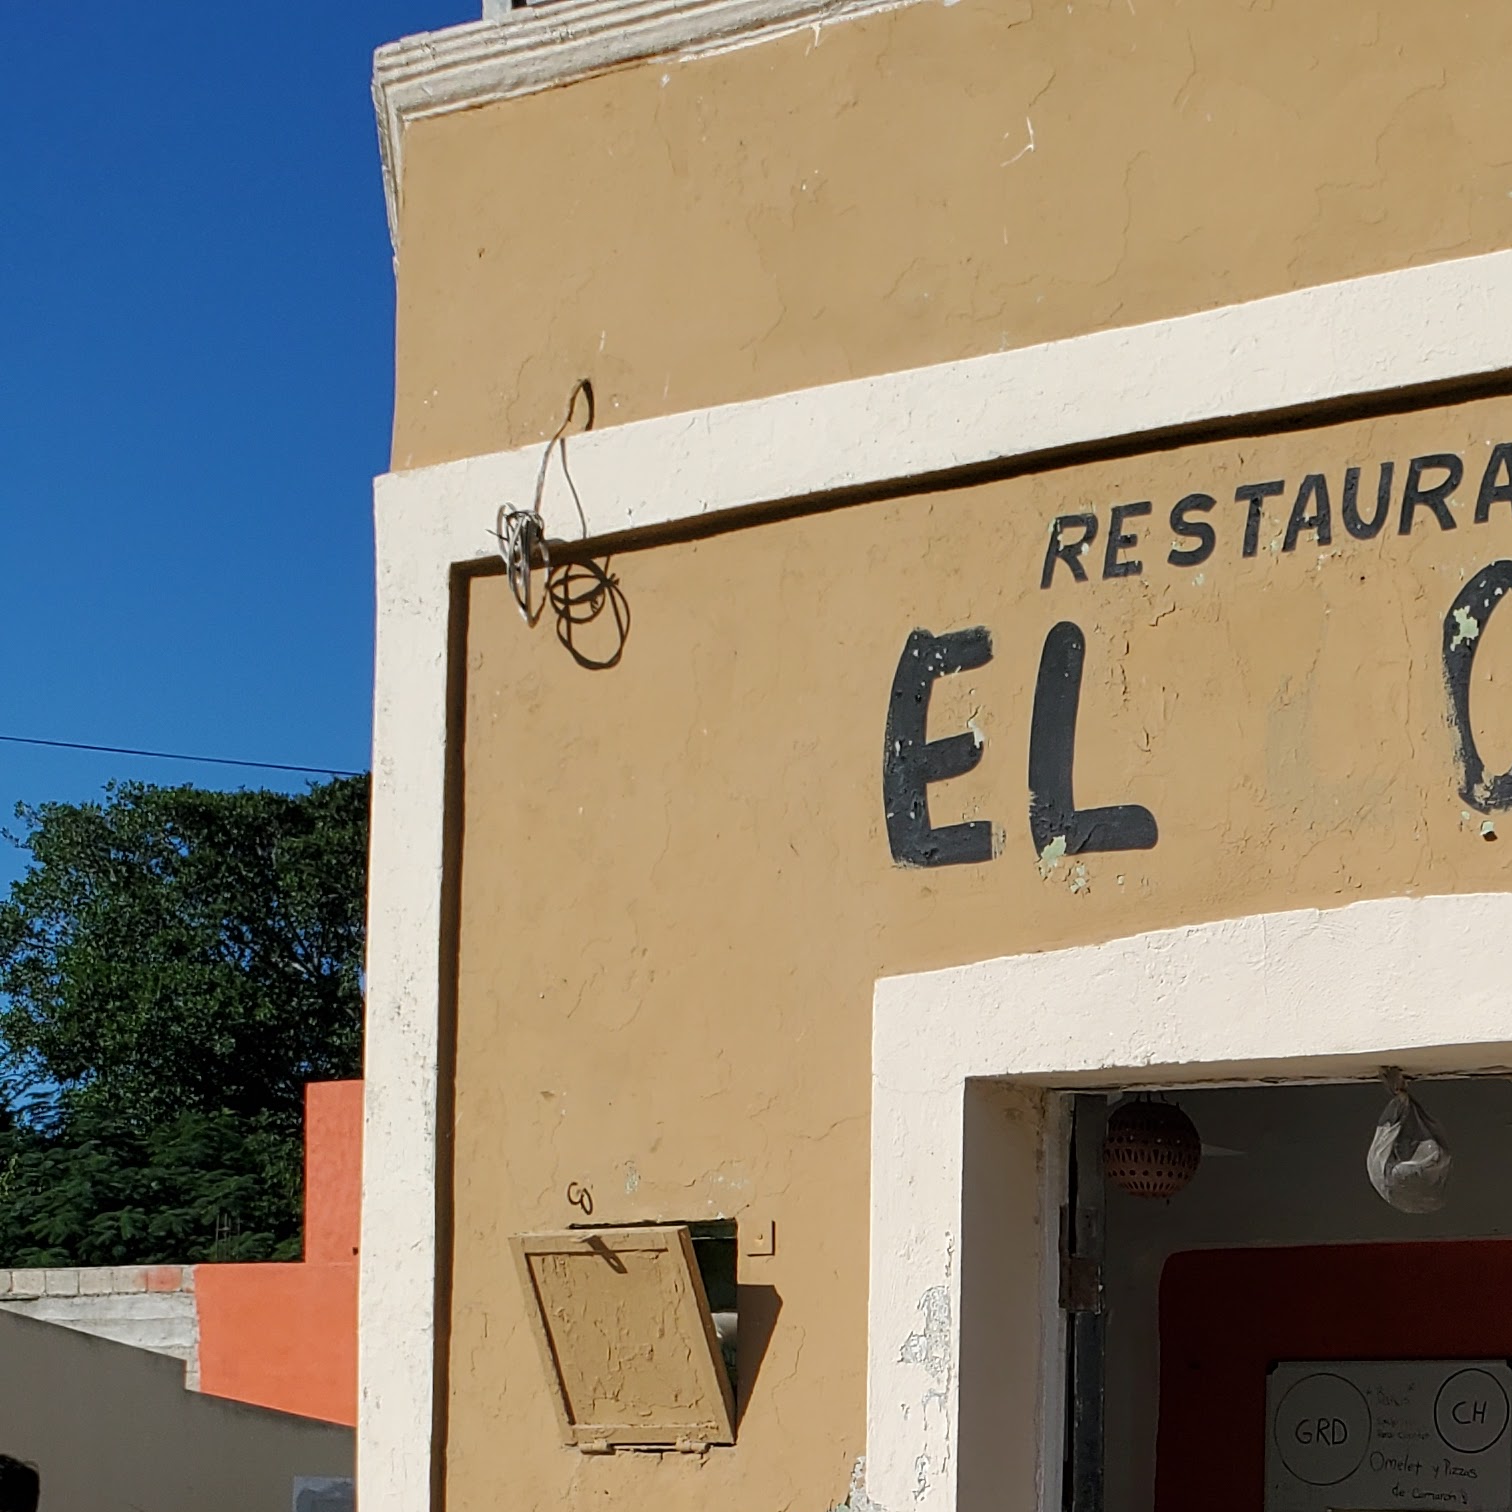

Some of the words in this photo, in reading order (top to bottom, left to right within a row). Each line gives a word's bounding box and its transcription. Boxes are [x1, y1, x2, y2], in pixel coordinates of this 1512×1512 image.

[884, 619, 1158, 868] EL
[1452, 1401, 1488, 1424] CH
[1295, 1418, 1348, 1445] GRD
[1369, 1451, 1422, 1475] Omelet
